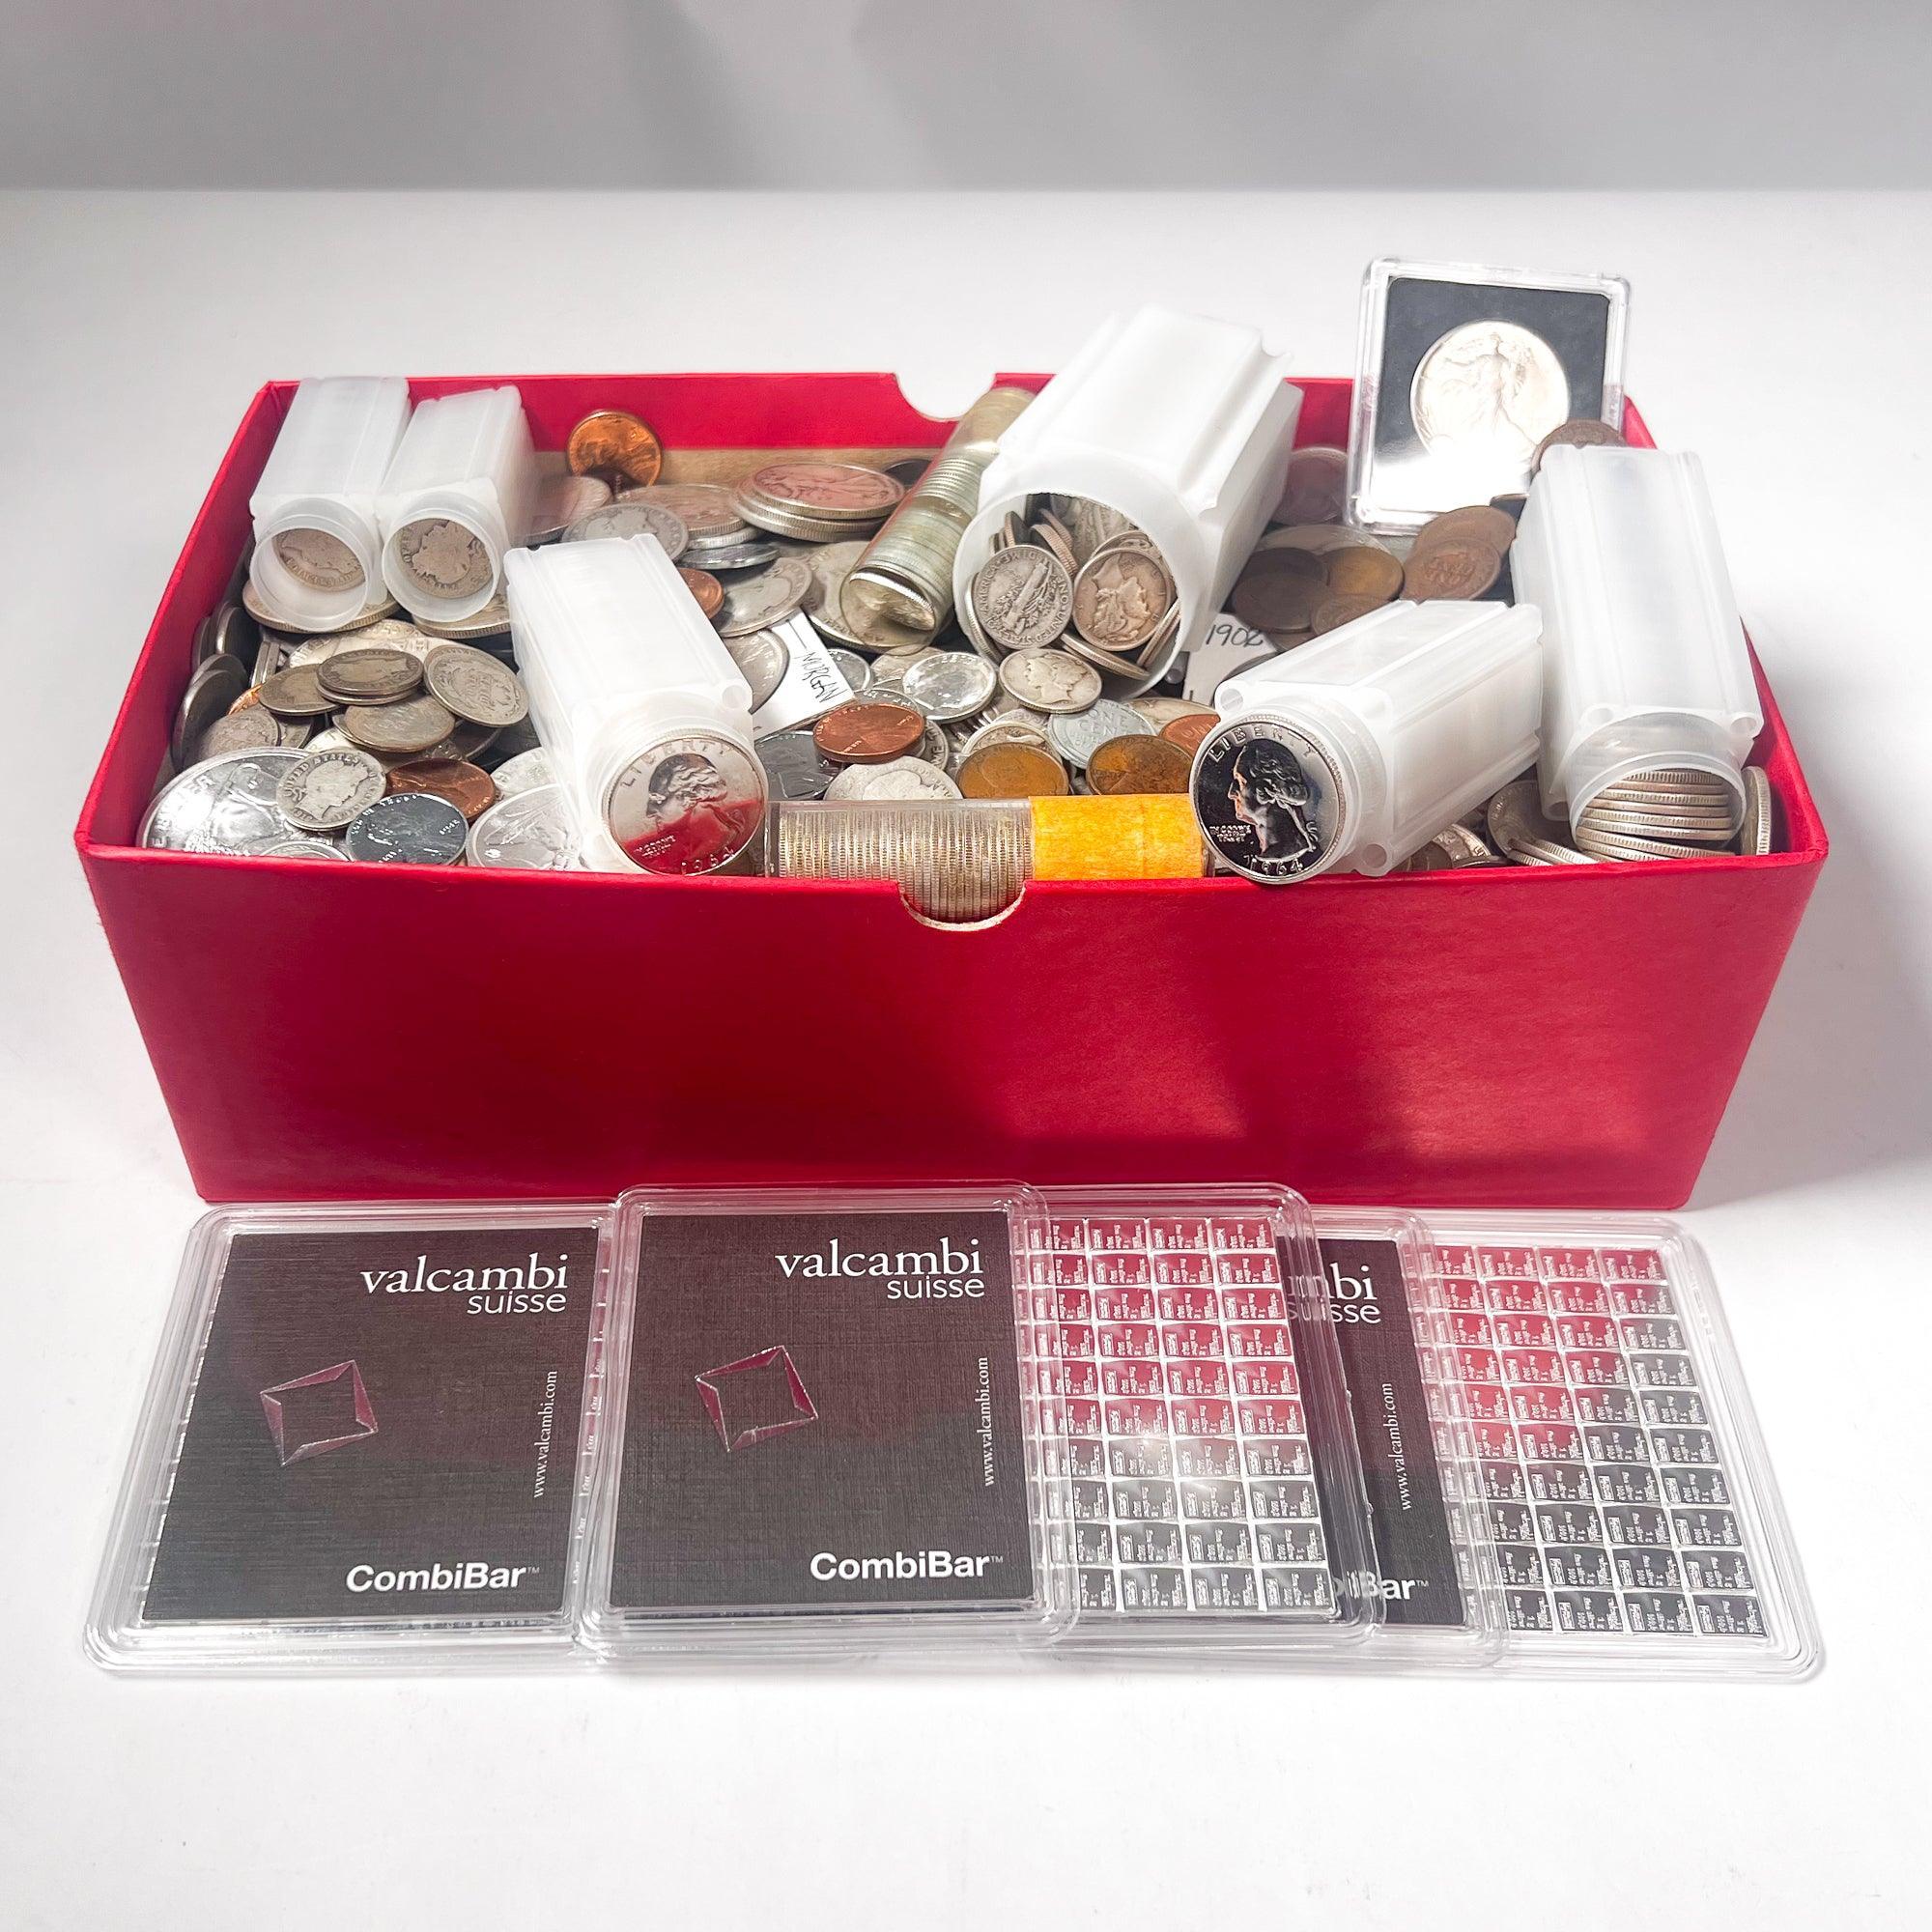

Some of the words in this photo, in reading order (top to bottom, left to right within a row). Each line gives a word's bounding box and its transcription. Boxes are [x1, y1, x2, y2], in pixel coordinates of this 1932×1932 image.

[801, 651, 849, 703] MORGAN
[1208, 725, 1320, 763] LIBERTY
[360, 1252, 569, 1293] valcambi
[775, 1237, 984, 1278] valcambi
[467, 1291, 568, 1315] suisse
[886, 1275, 985, 1299] suisse
[533, 1370, 558, 1498] www.valcambi.com
[976, 1356, 996, 1488] www.valcambi.com
[1381, 1382, 1412, 1511] www.valcambi.com
